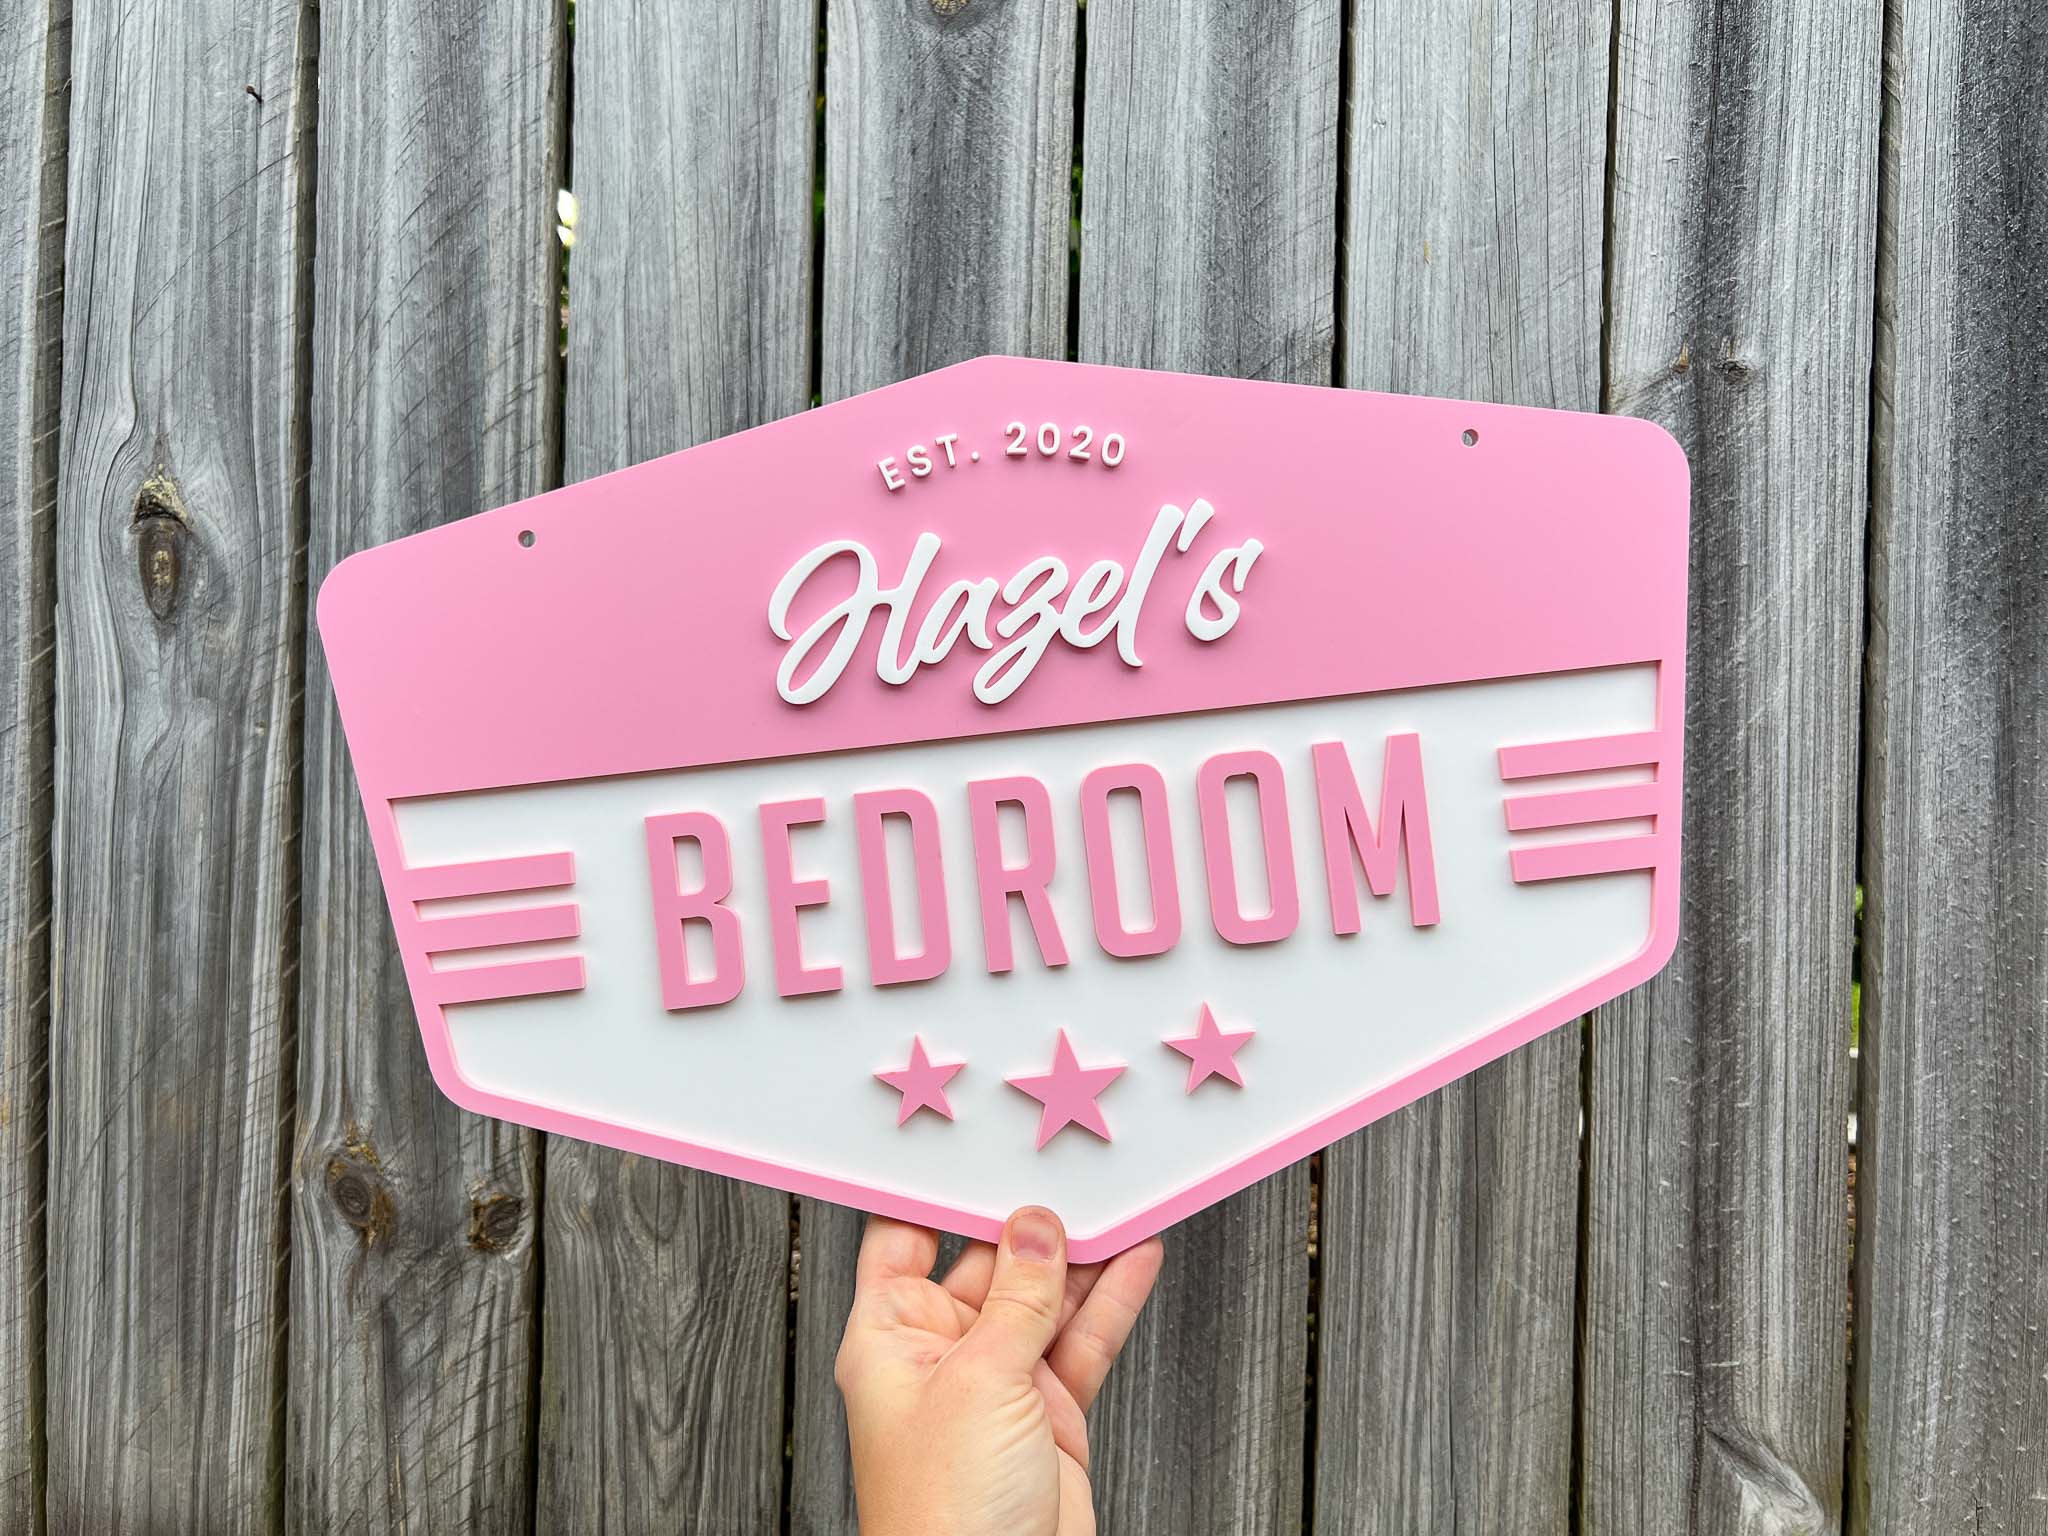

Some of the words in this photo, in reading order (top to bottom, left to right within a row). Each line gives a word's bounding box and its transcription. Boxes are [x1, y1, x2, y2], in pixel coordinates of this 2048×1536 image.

[877, 432, 981, 492] EST.
[1004, 420, 1127, 468] 2020
[767, 497, 1265, 705] Hazel's
[643, 732, 1441, 1011] BEDROOM
